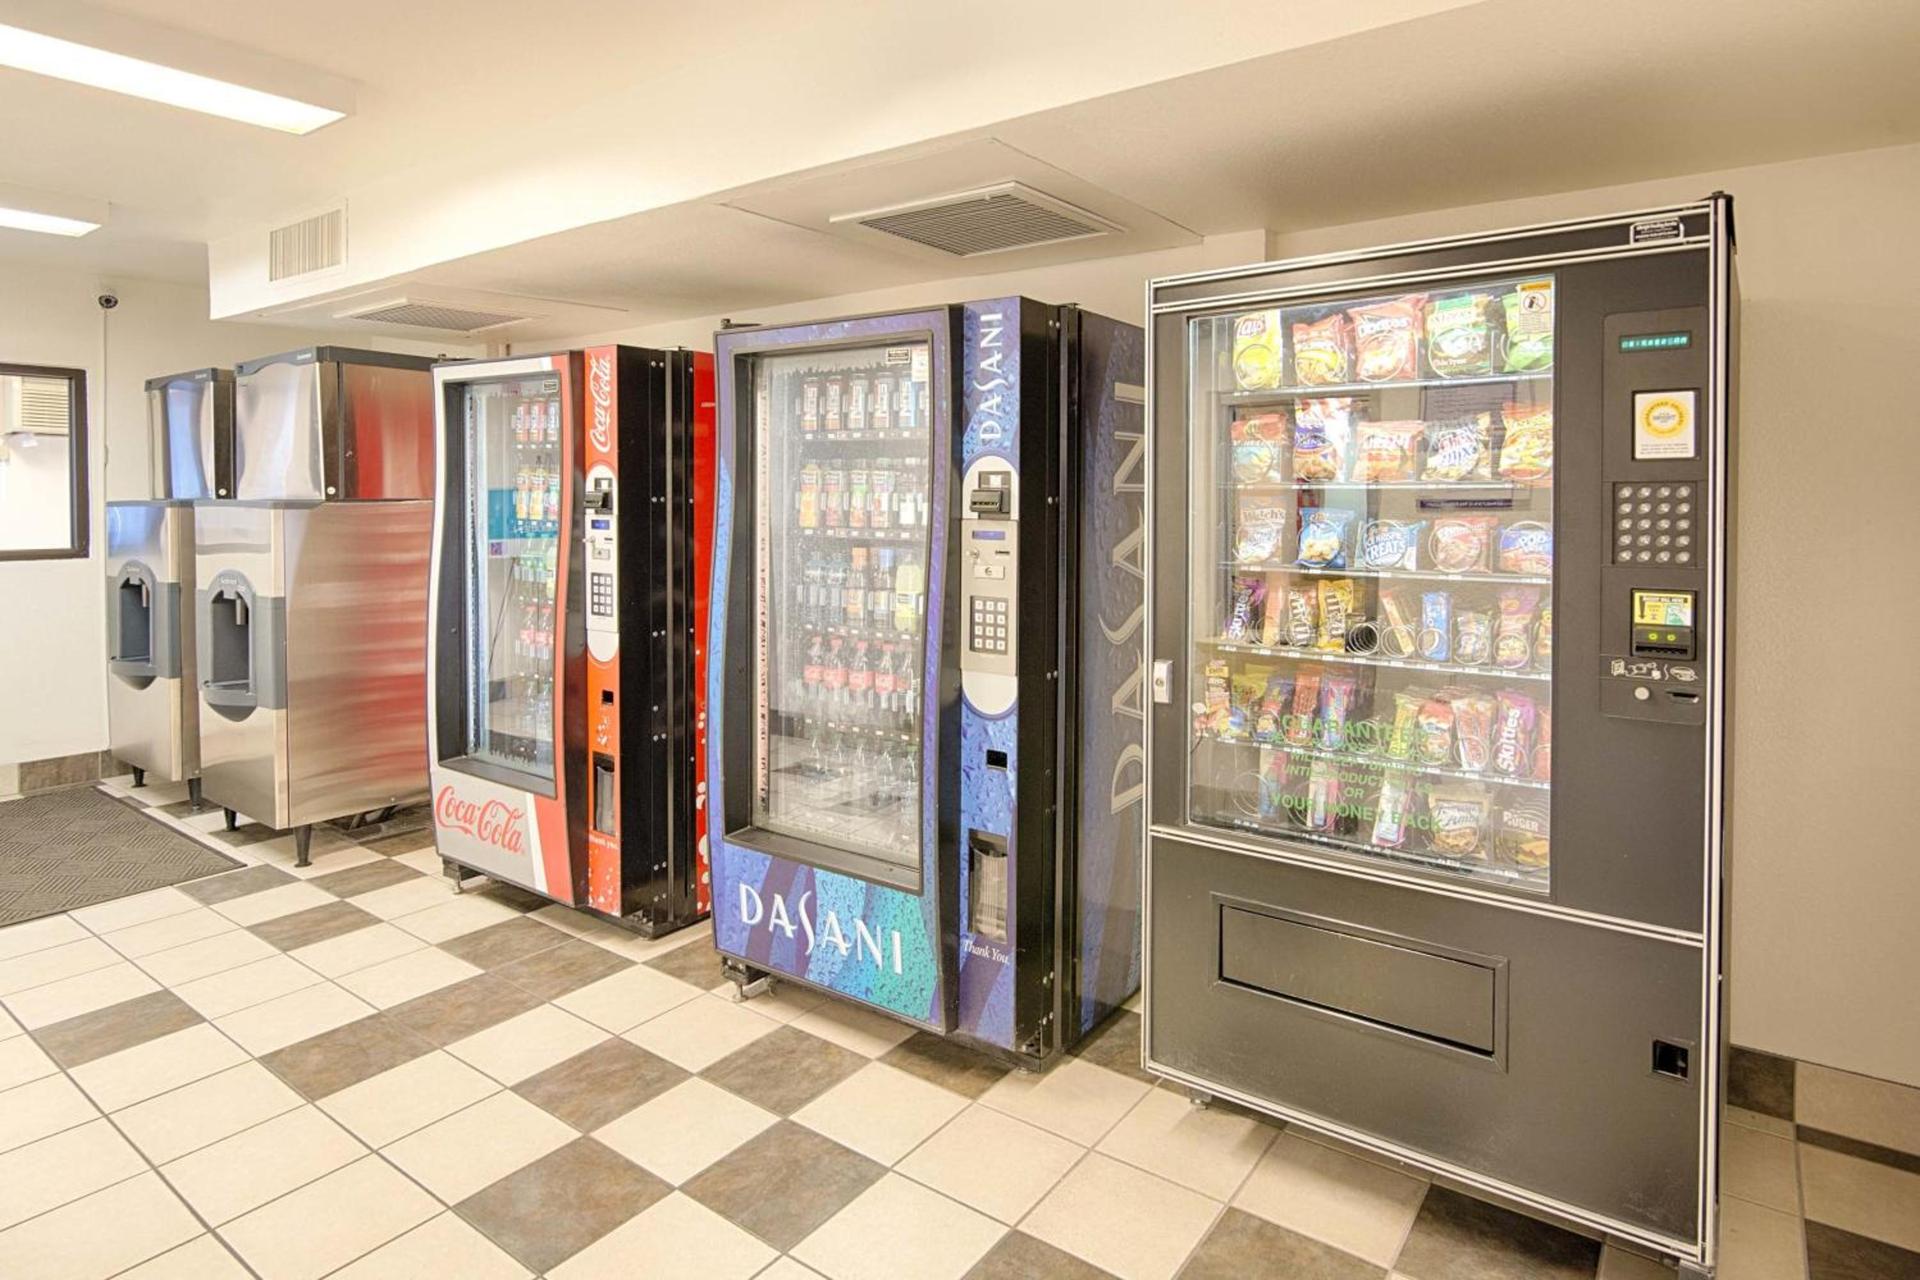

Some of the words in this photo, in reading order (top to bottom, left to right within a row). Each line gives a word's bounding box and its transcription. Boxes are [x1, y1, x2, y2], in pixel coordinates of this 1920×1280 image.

[590, 353, 611, 454] Coca-Cola
[973, 313, 1009, 441] DASANI
[1496, 708, 1521, 772] Skittles
[436, 785, 525, 853] Coca-Cola
[1343, 787, 1365, 799] OR
[739, 882, 902, 975] DASANI
[964, 939, 991, 959] Thank
[991, 947, 1009, 964] You
